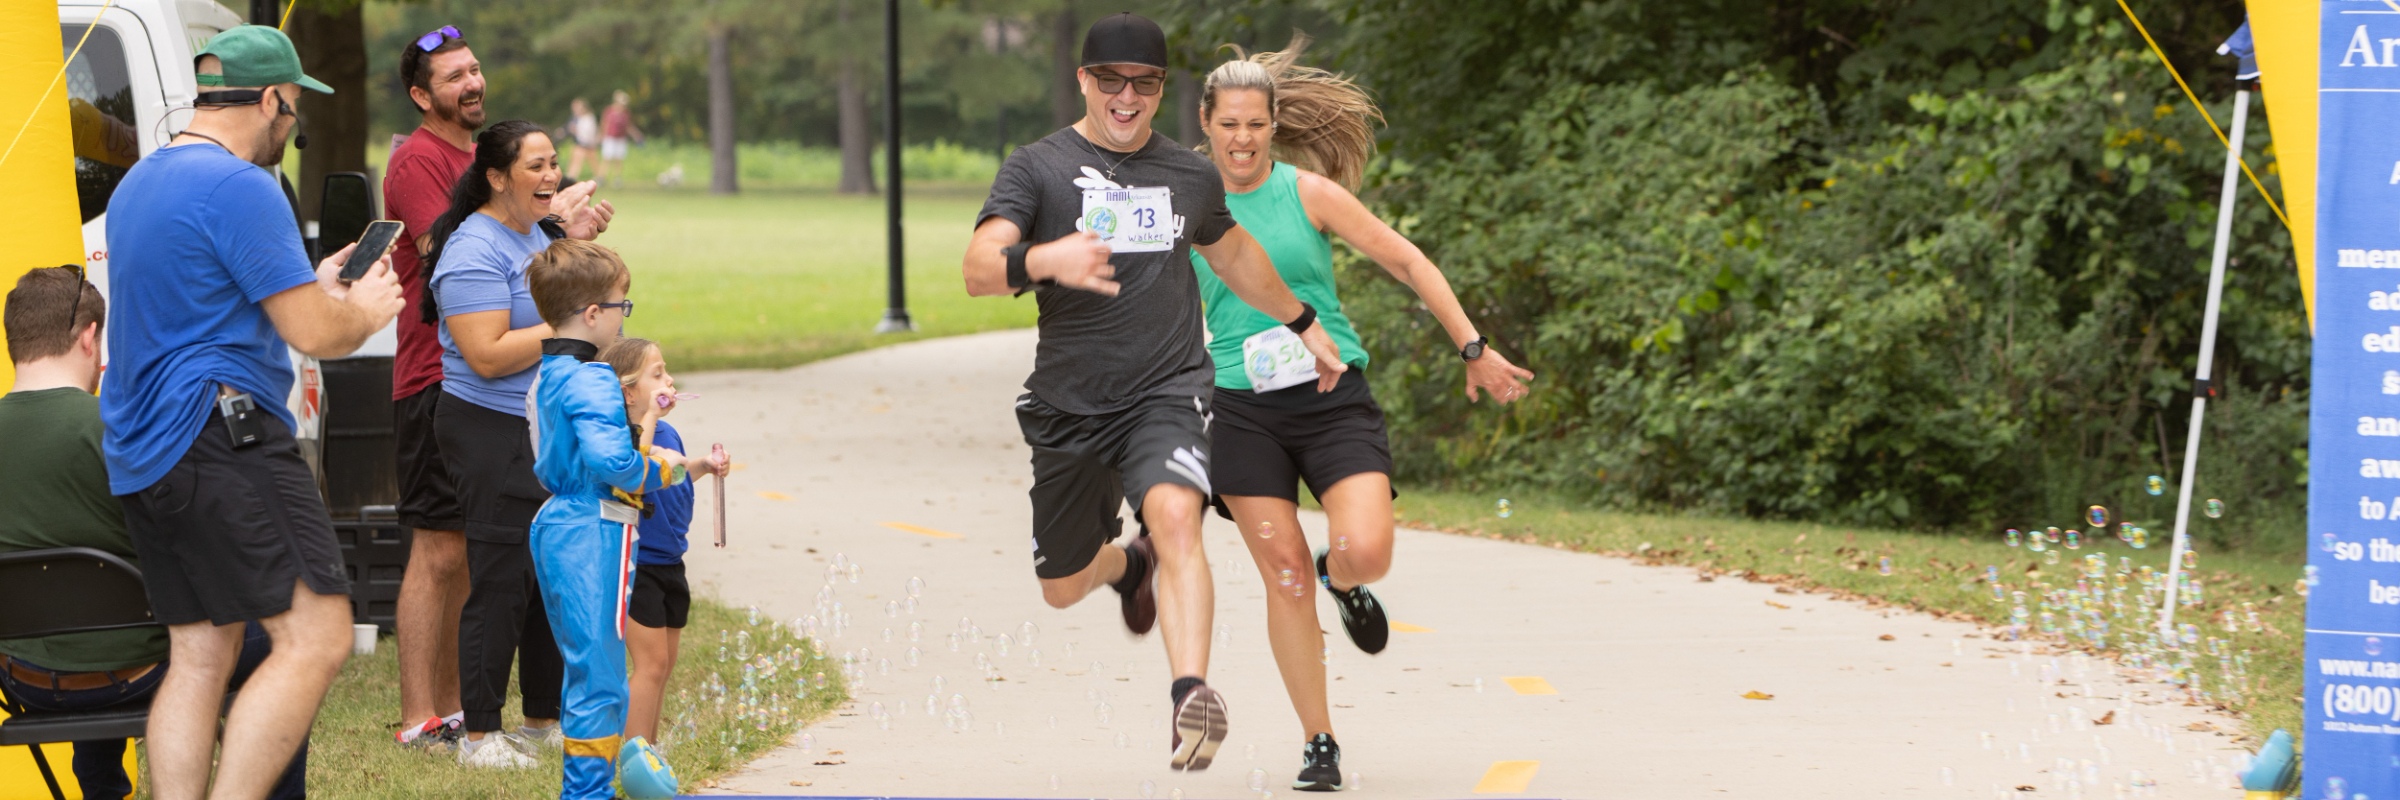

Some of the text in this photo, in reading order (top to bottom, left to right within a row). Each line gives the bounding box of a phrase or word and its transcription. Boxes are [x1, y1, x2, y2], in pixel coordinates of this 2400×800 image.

[1133, 208, 1155, 228] 13
[2357, 416, 2400, 437] an
[2359, 496, 2386, 520] to
[2333, 541, 2364, 561] so
[2319, 658, 2400, 679] www.na
[2323, 683, 2400, 721] (800)
